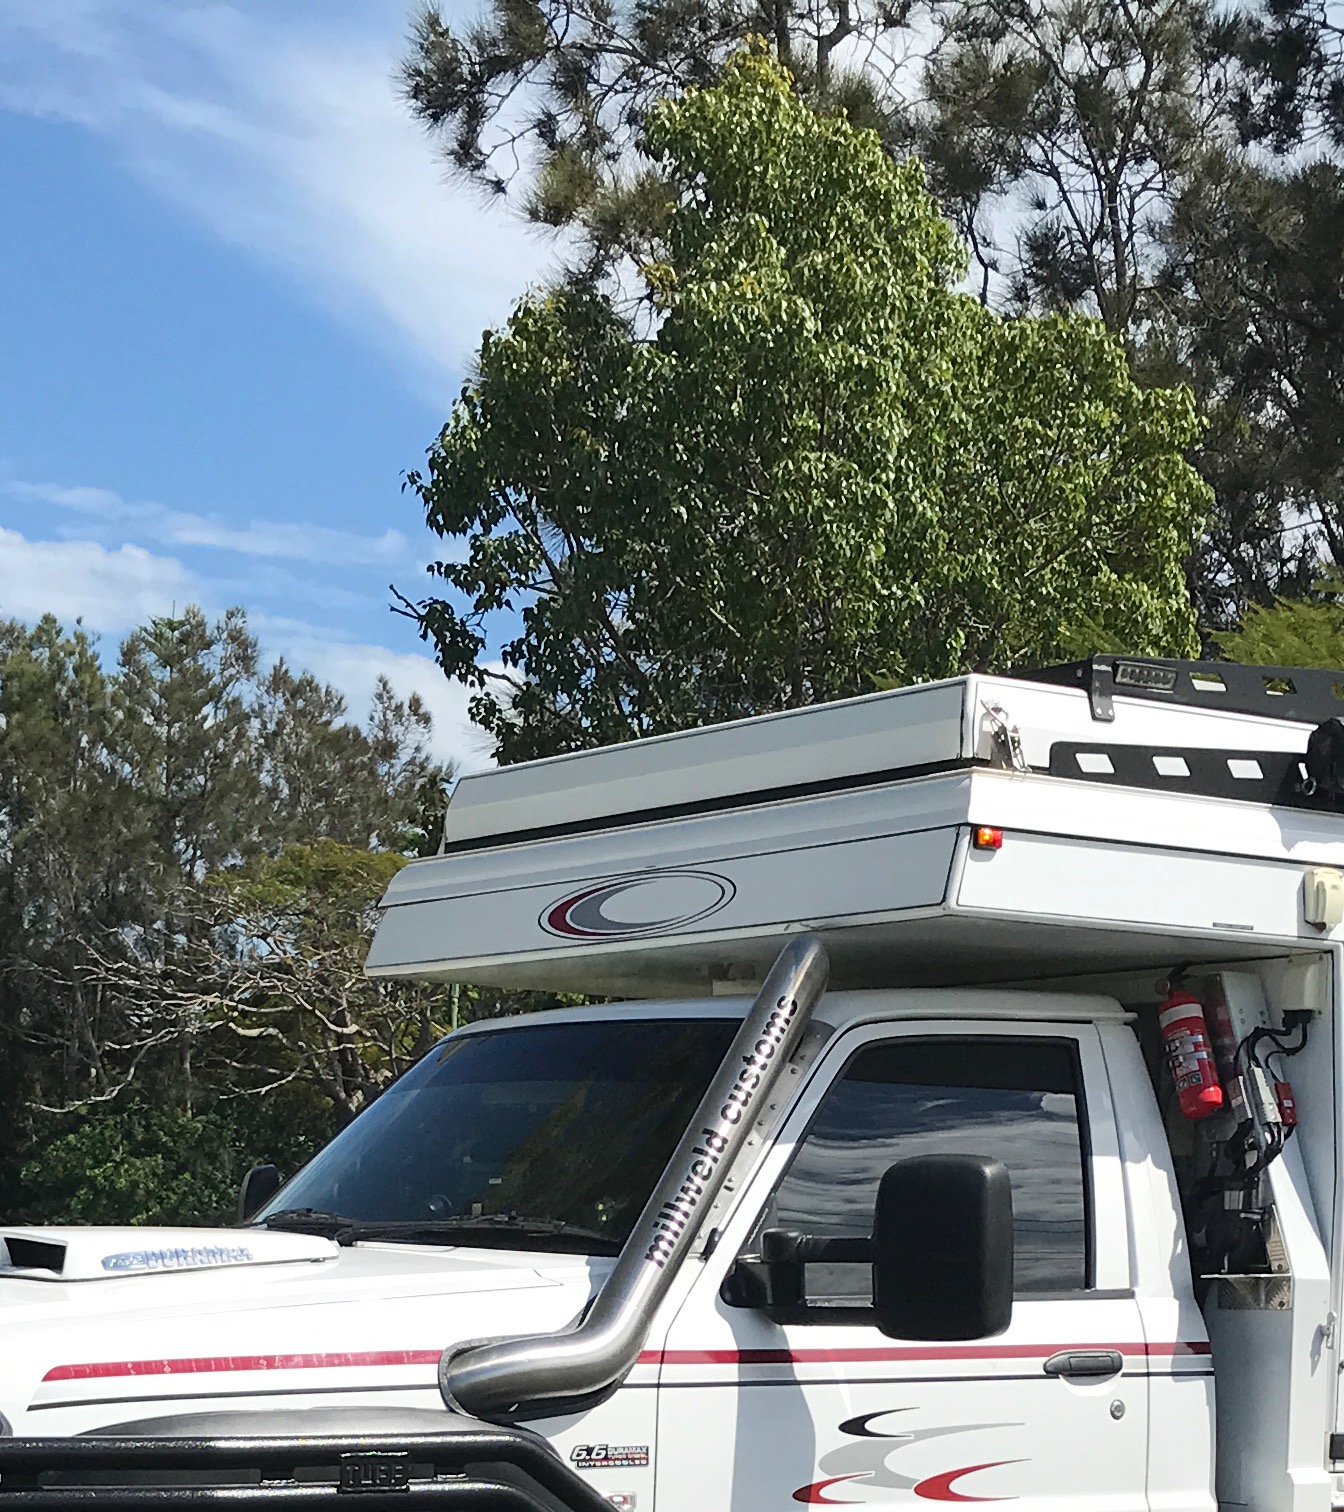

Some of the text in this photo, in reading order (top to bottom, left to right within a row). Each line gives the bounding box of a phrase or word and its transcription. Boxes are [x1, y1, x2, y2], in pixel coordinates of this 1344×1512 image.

[644, 995, 798, 1268] millweld customs
[570, 1444, 609, 1461] 6.6
[345, 1464, 404, 1484] TUFF
